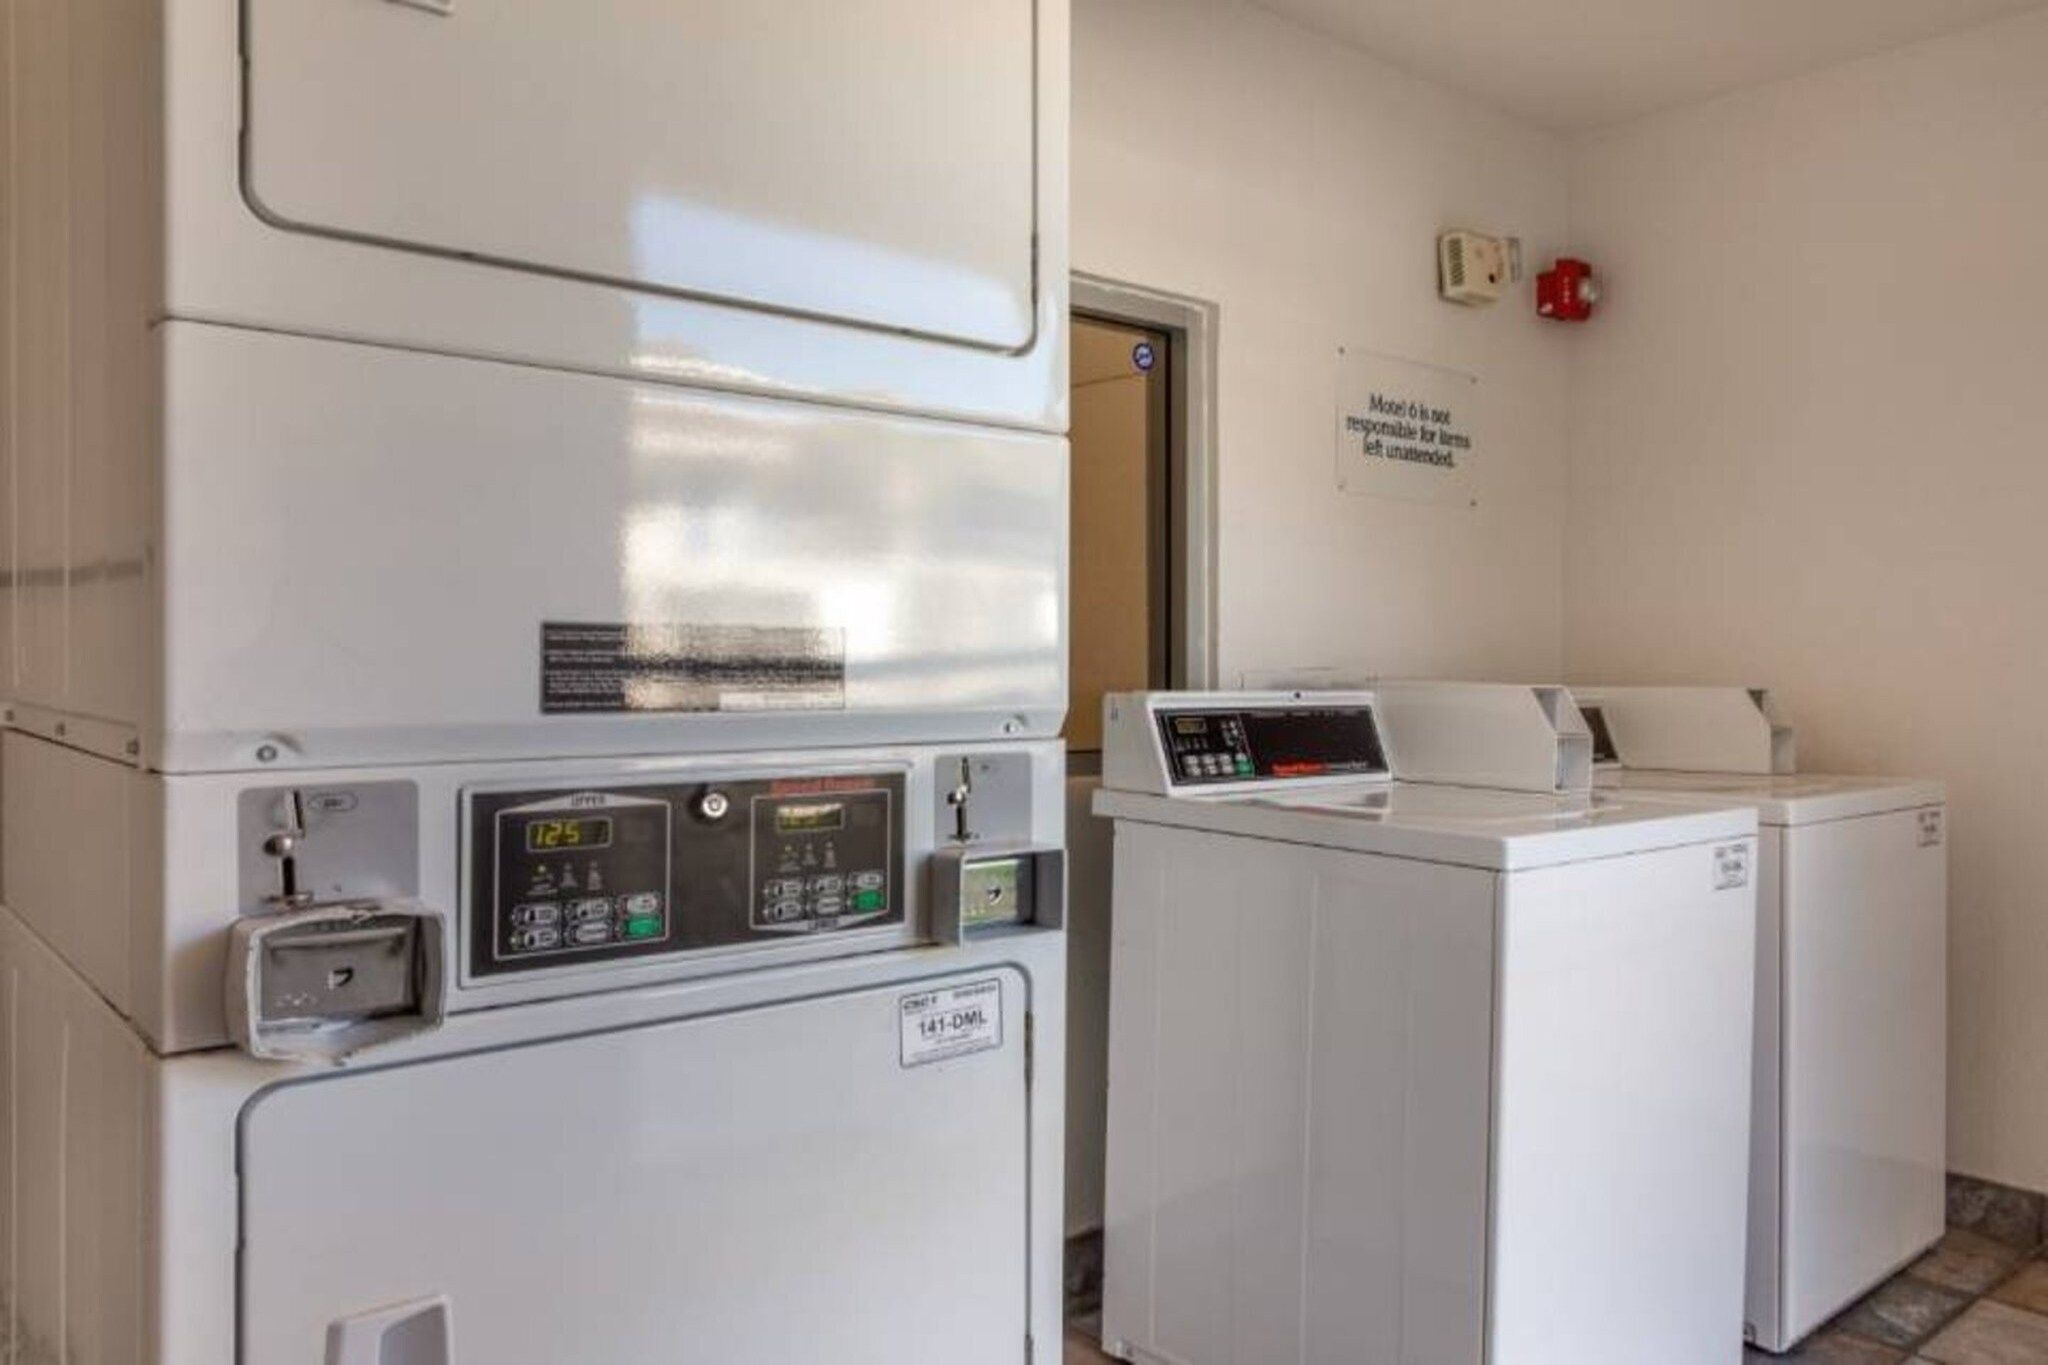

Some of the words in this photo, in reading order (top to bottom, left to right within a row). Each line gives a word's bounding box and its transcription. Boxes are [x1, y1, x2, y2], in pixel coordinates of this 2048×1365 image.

[1369, 393, 1406, 418] Motel
[1408, 403, 1418, 421] 6
[1420, 404, 1430, 422] is
[1431, 408, 1451, 426] not
[1346, 415, 1418, 441] responsible
[1420, 426, 1436, 443] for
[1439, 429, 1472, 449] items
[1363, 438, 1384, 459] left
[1386, 443, 1455, 468] unattended.
[533, 821, 581, 847] 125
[917, 1011, 987, 1035] 141-DML
